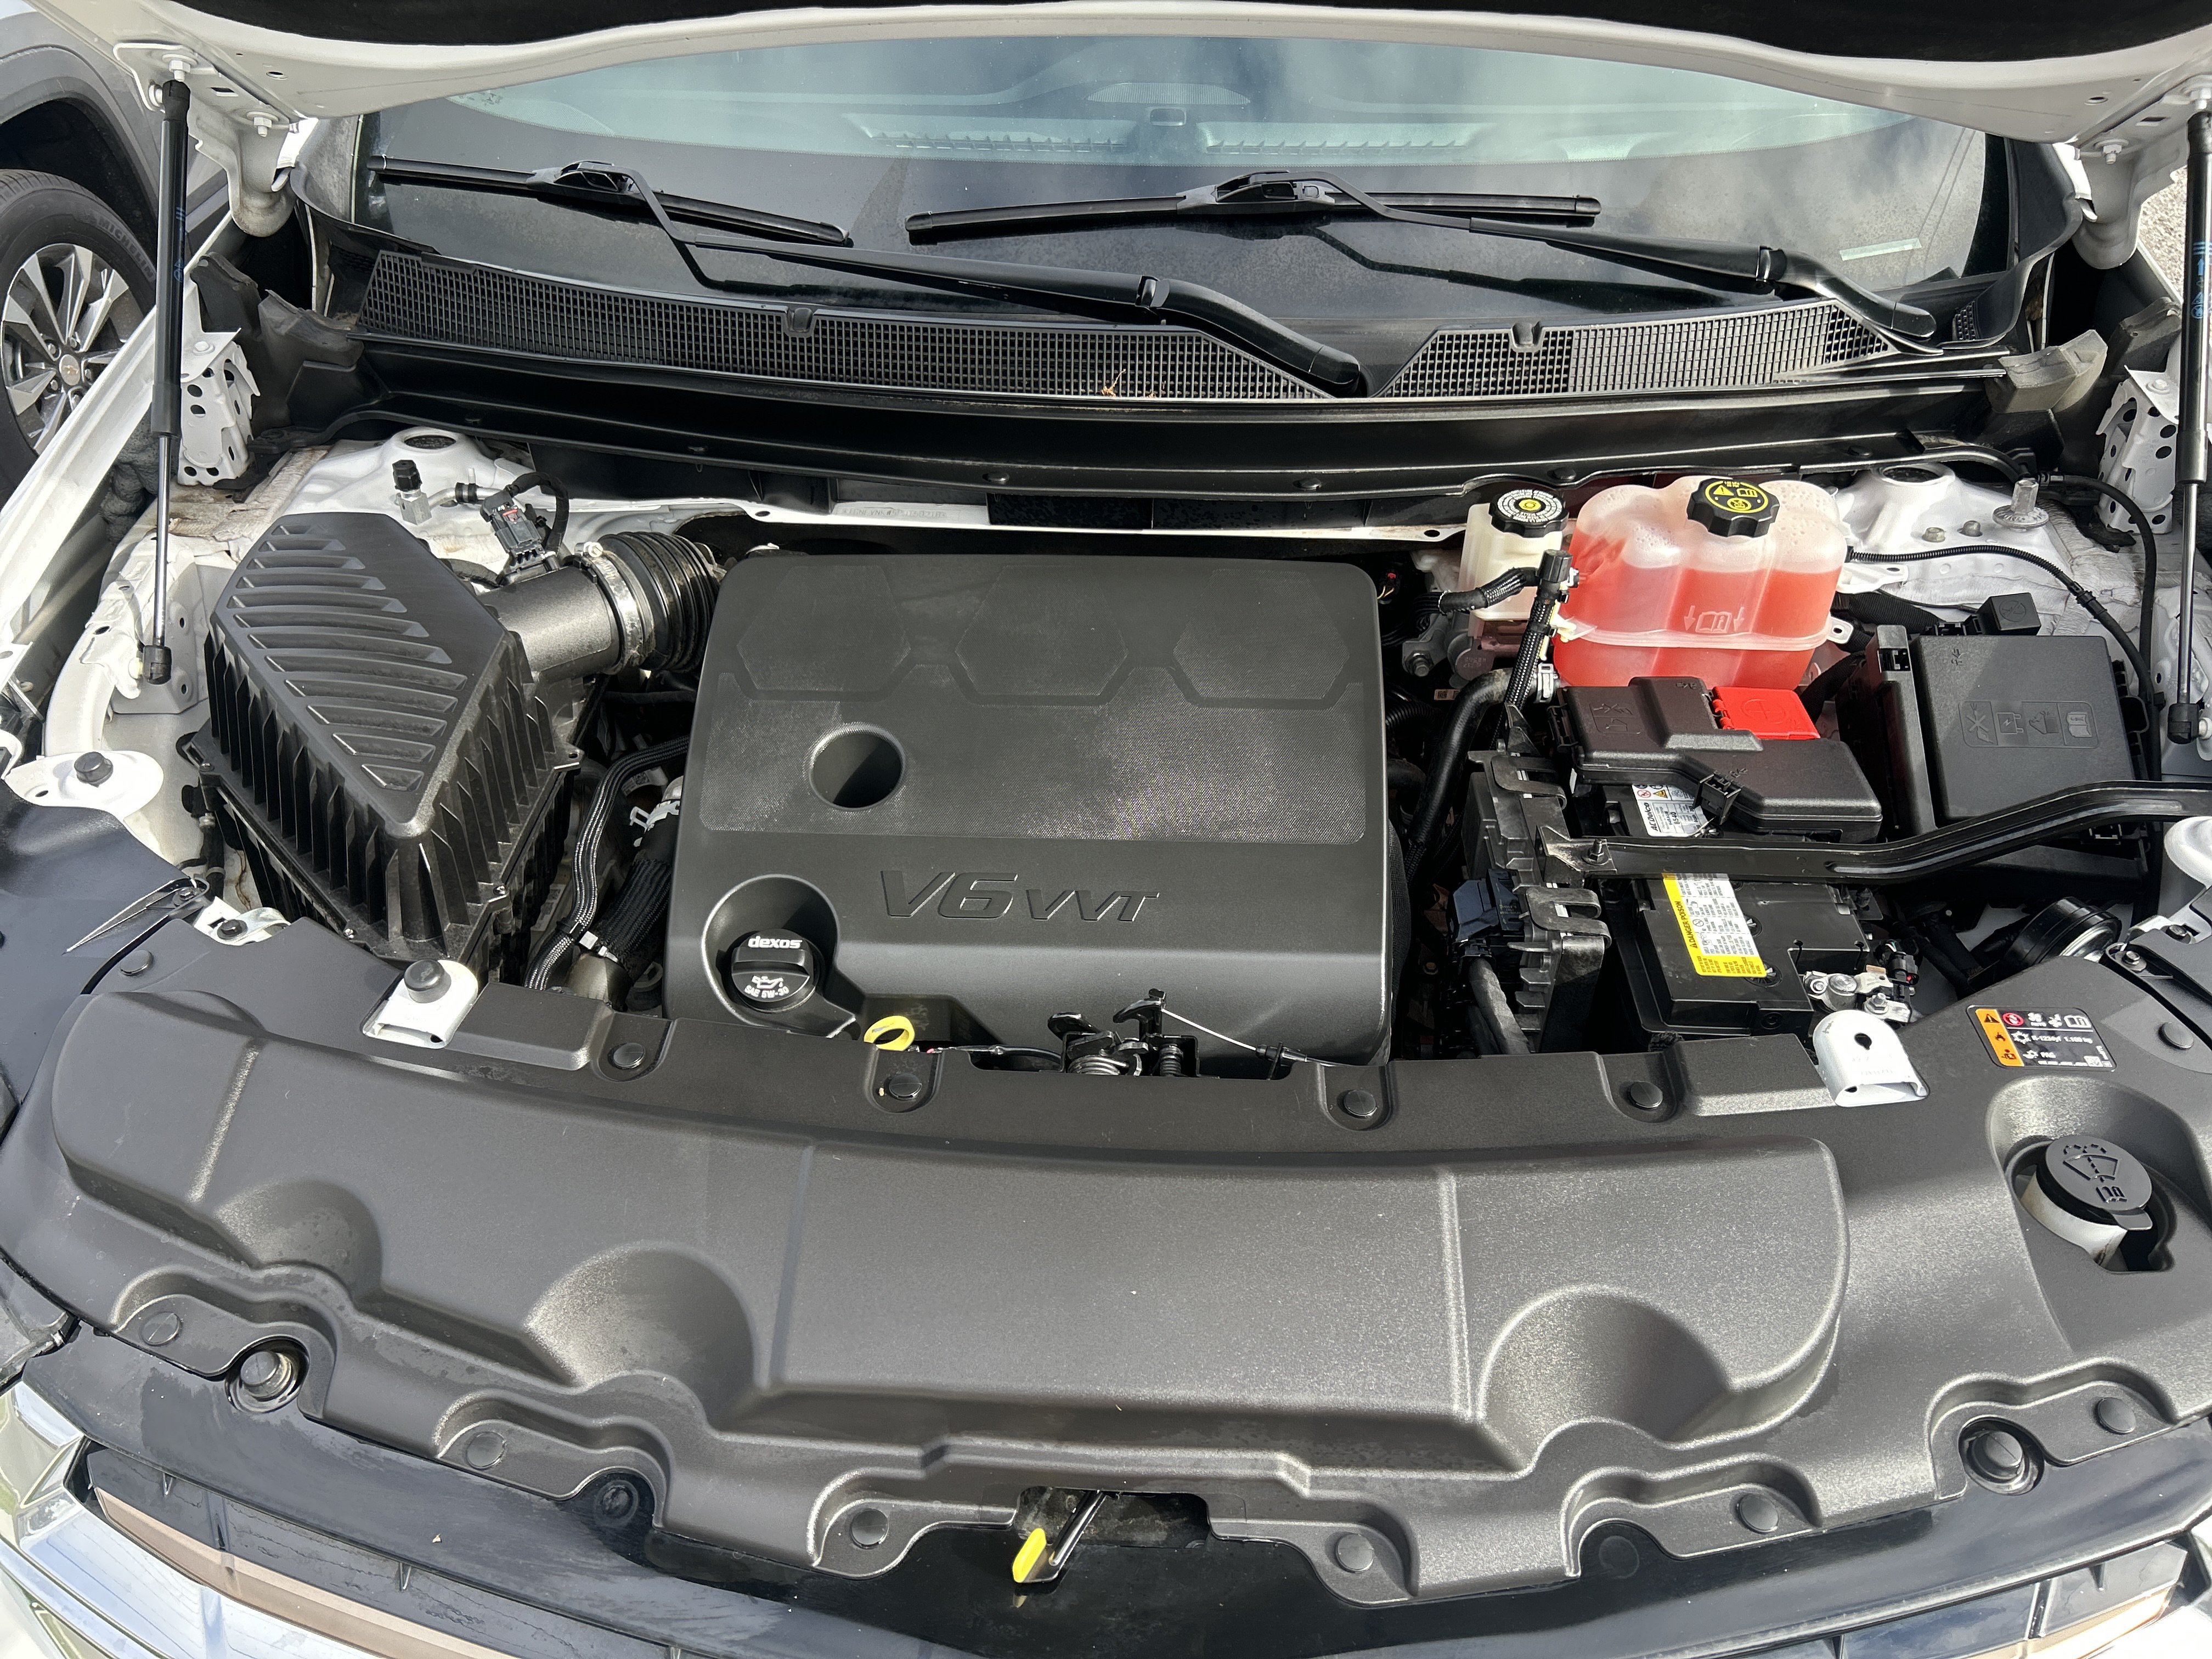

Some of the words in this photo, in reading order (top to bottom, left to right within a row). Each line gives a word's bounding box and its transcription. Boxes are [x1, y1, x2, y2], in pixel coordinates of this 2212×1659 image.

[1644, 802, 1658, 832] ACDelco
[881, 871, 1019, 919] V6
[1025, 889, 1160, 922] VVT
[748, 936, 803, 949] dexos
[744, 985, 760, 997] SAE
[761, 986, 789, 998] 5W-30
